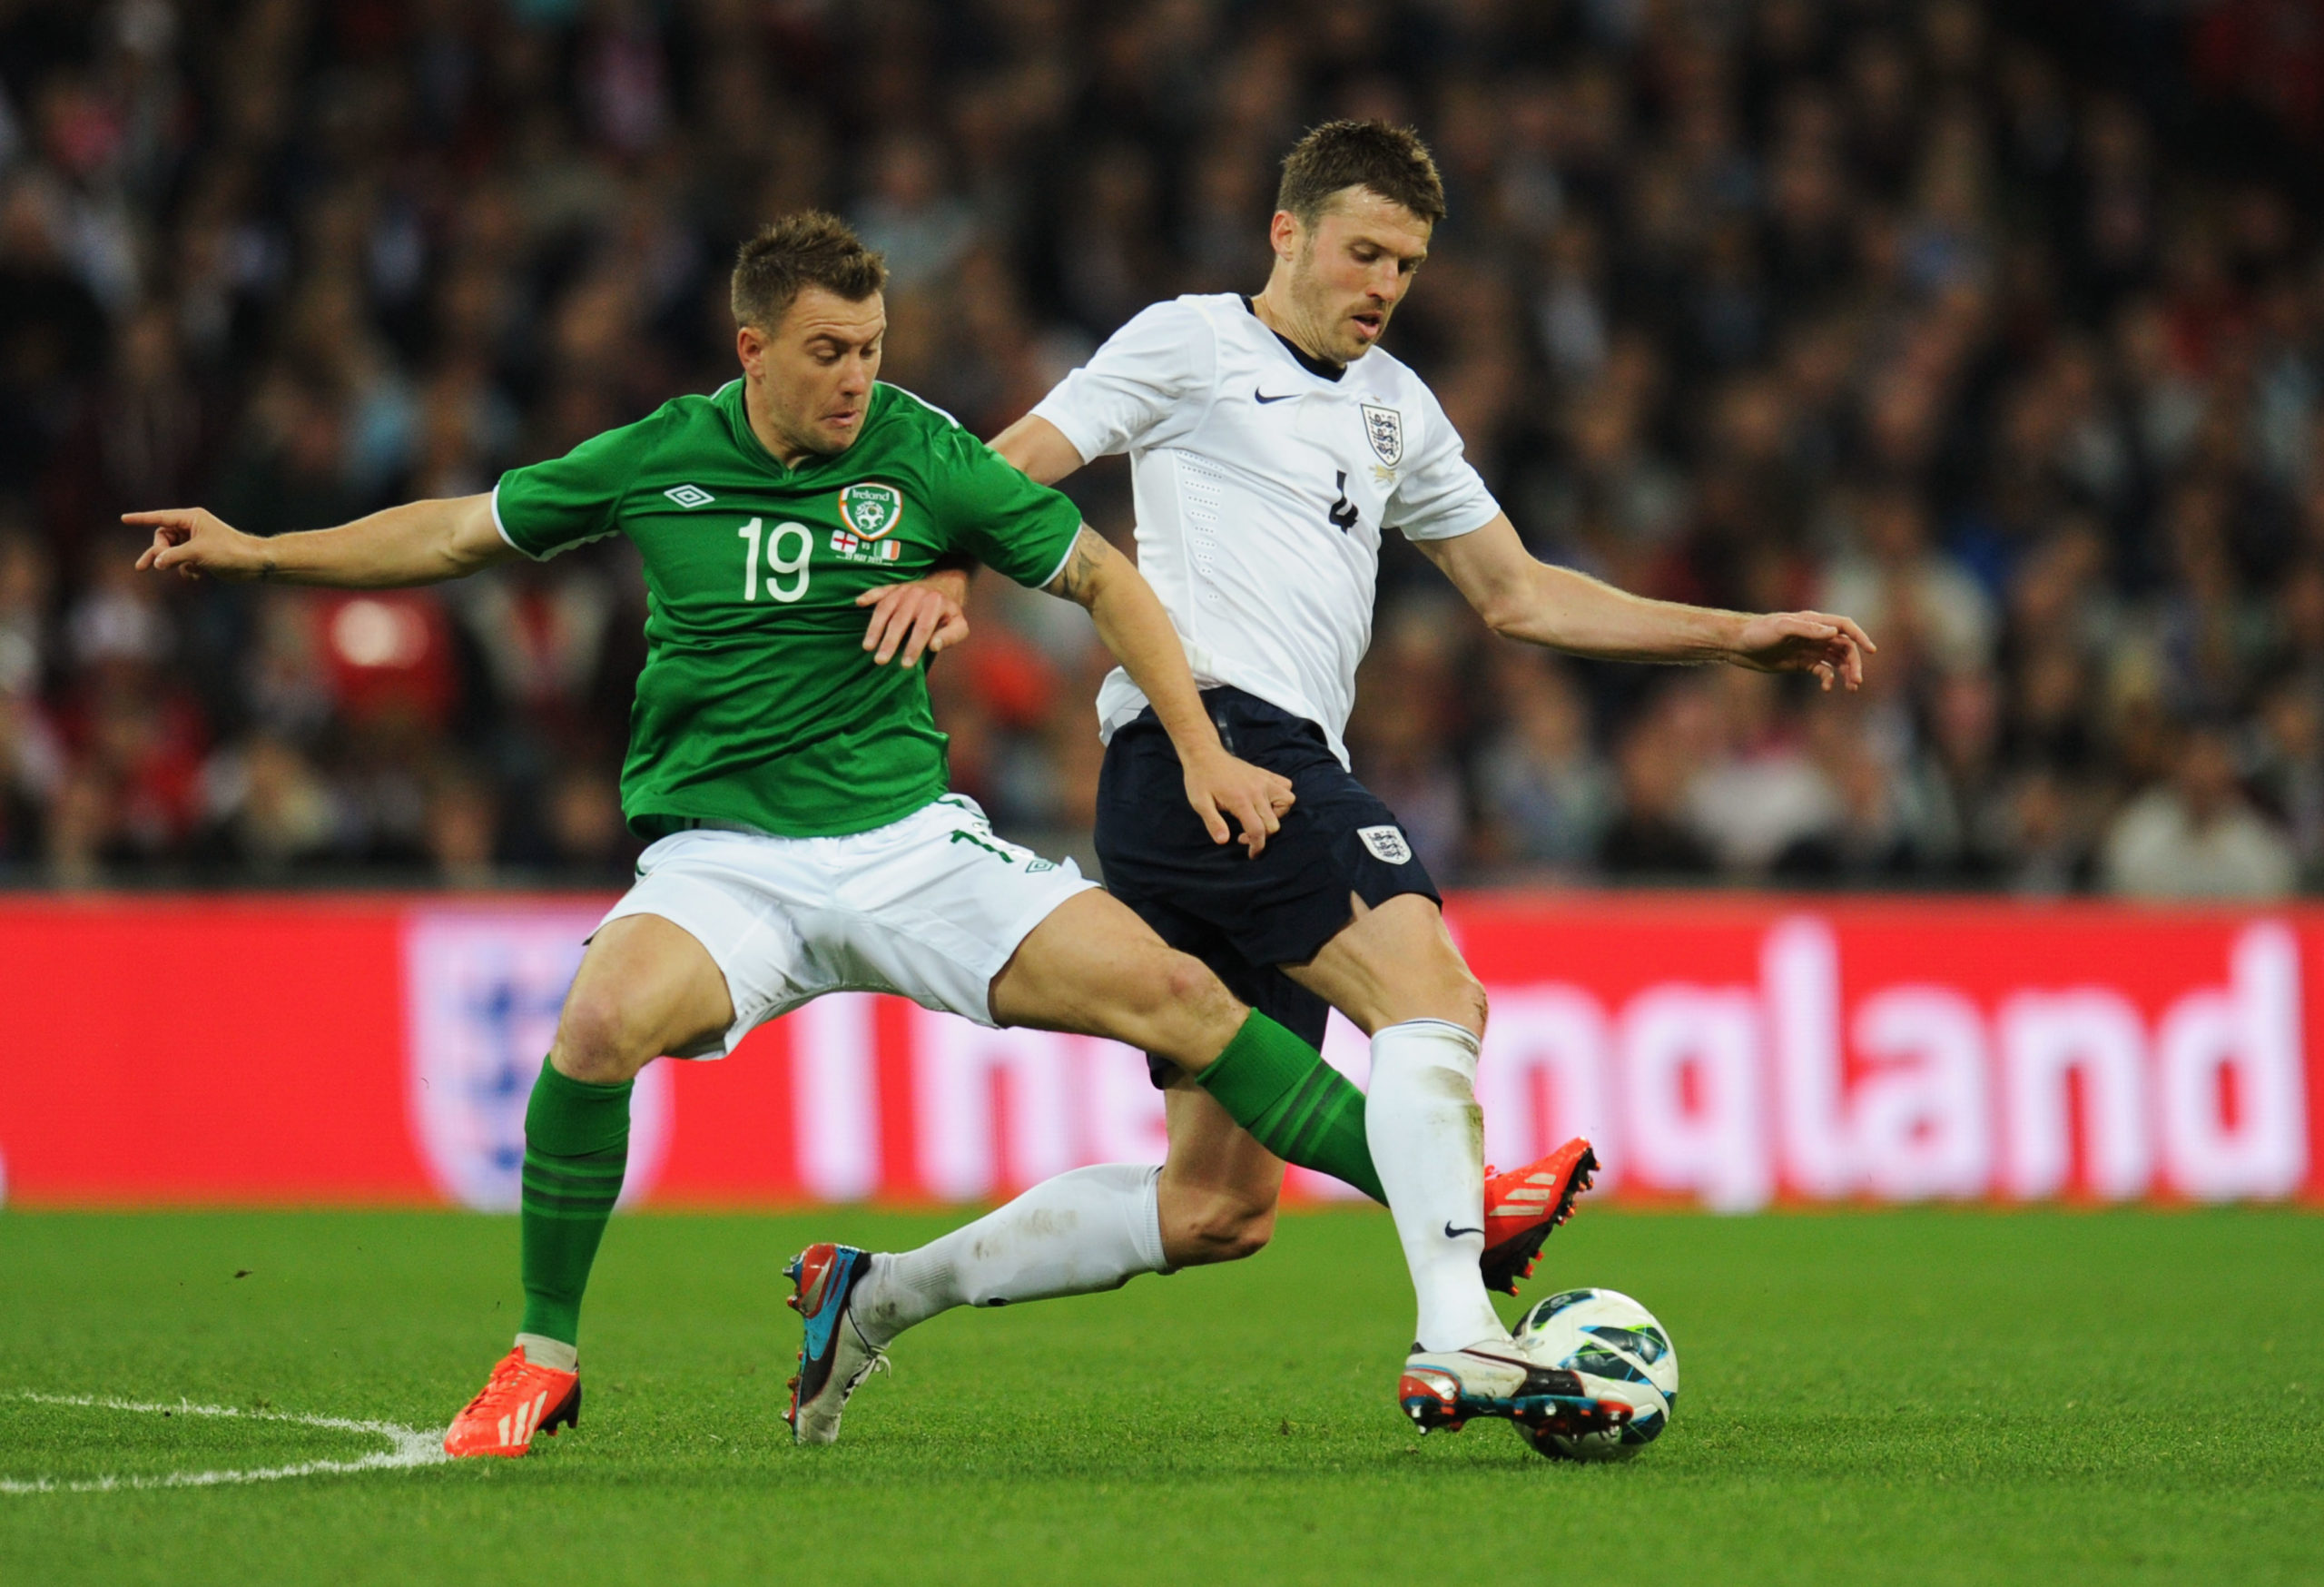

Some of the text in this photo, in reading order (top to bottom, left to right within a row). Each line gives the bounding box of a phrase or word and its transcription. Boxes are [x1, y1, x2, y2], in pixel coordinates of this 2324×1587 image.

[852, 488, 890, 501] Ireland
[738, 518, 813, 602] 19
[1300, 915, 2306, 1212] ngland
